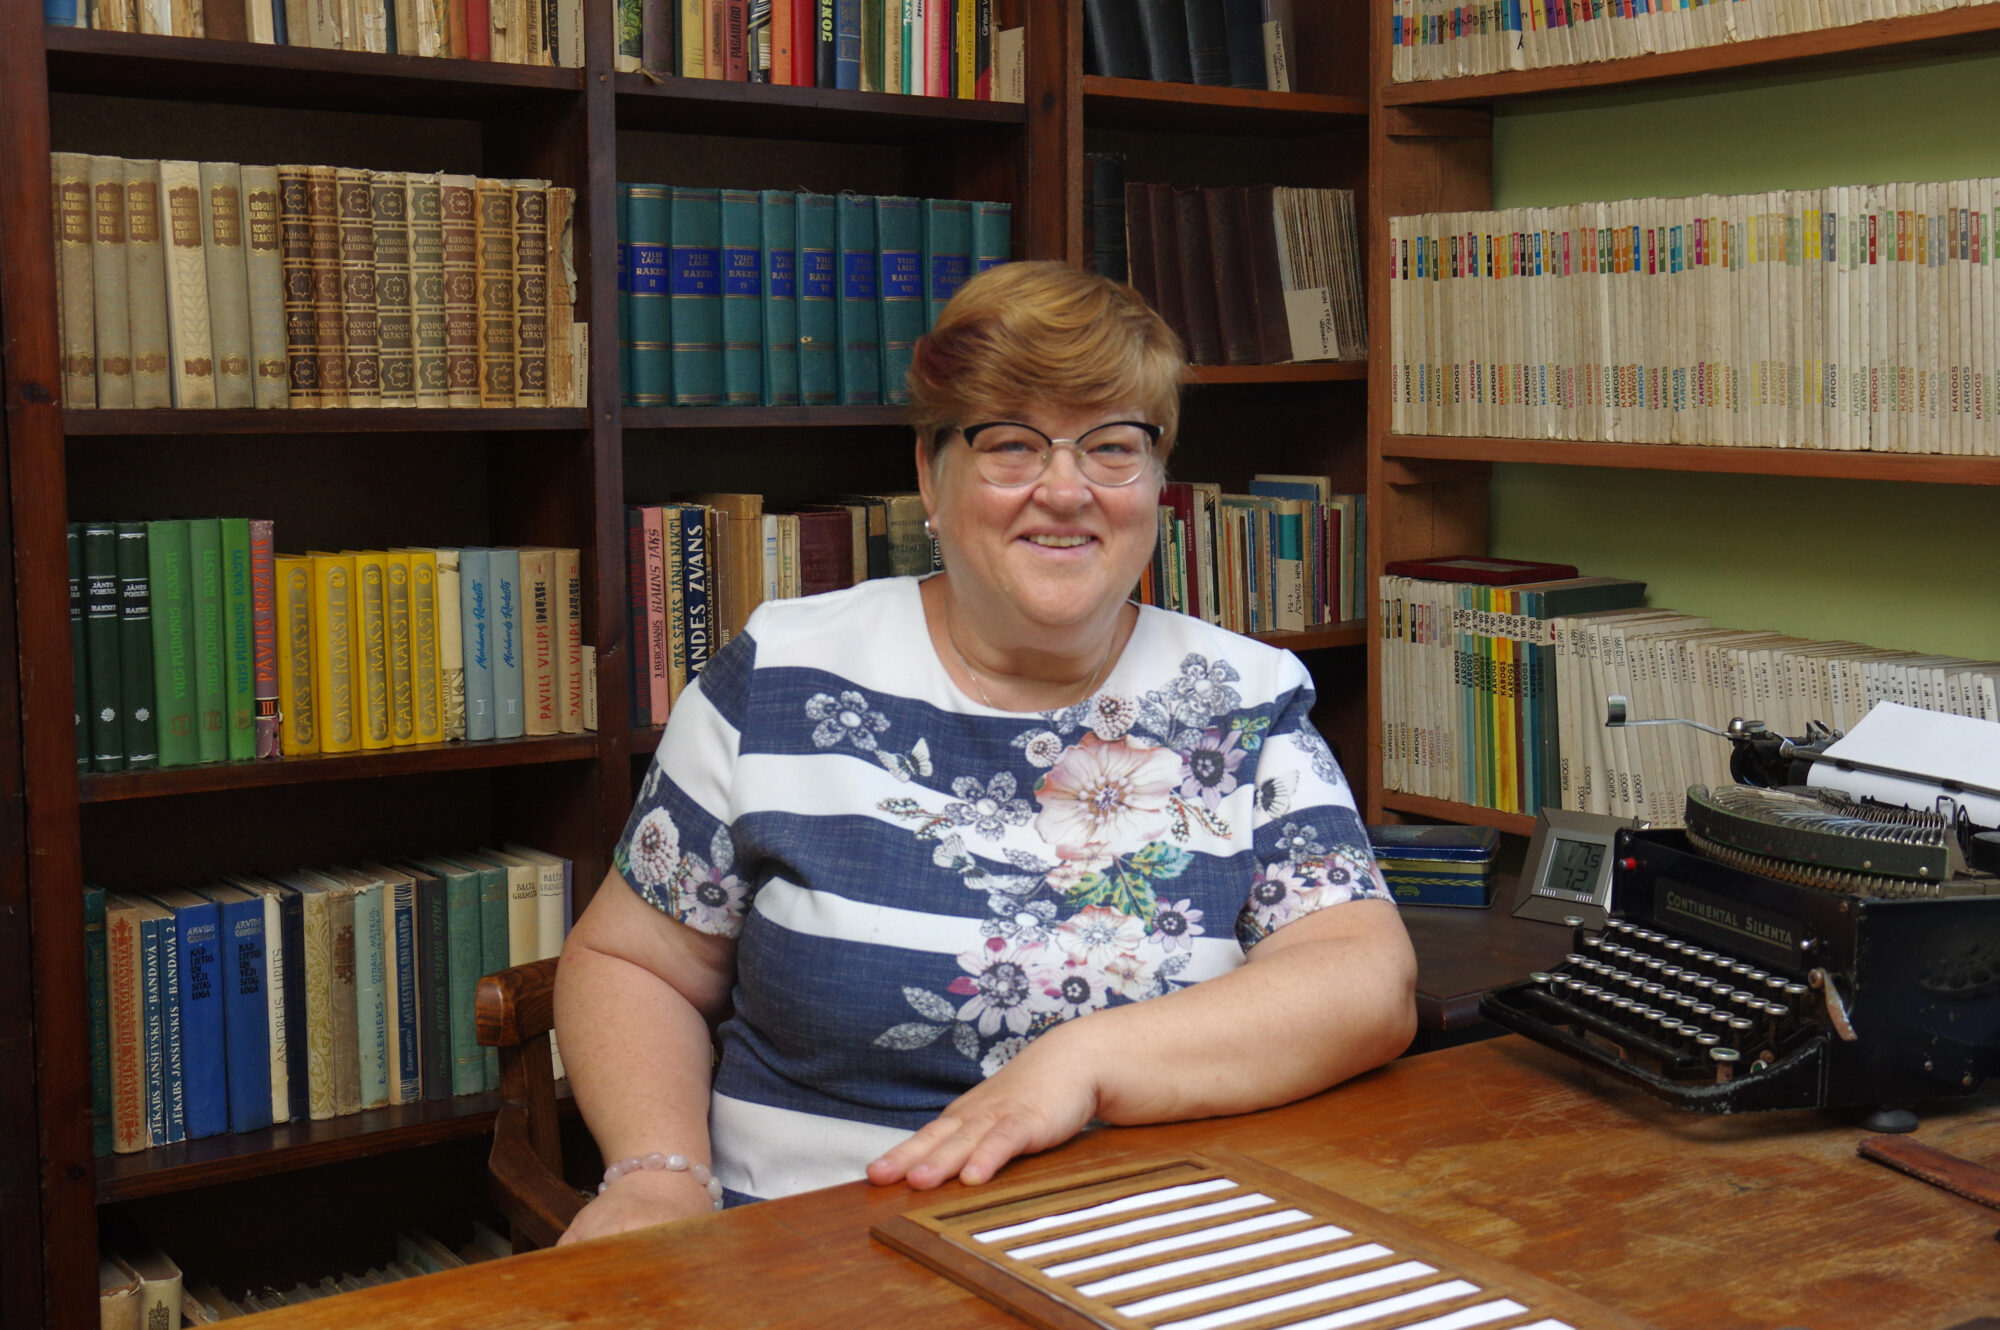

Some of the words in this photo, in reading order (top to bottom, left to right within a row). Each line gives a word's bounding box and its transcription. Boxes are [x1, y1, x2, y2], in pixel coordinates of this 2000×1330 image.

[648, 528, 661, 561] JĀKS
[688, 524, 705, 593] ZVANS
[649, 564, 663, 613] KLAUNS
[673, 642, 685, 668] TAS
[261, 700, 275, 716] III
[1621, 772, 1630, 803] KAROGS
[1634, 773, 1642, 804] KAROGS
[165, 925, 175, 933] 2
[1666, 890, 1738, 927] CONTINENTAL
[1744, 916, 1793, 944] SILENTA
[375, 1001, 385, 1069] SALENIEKS
